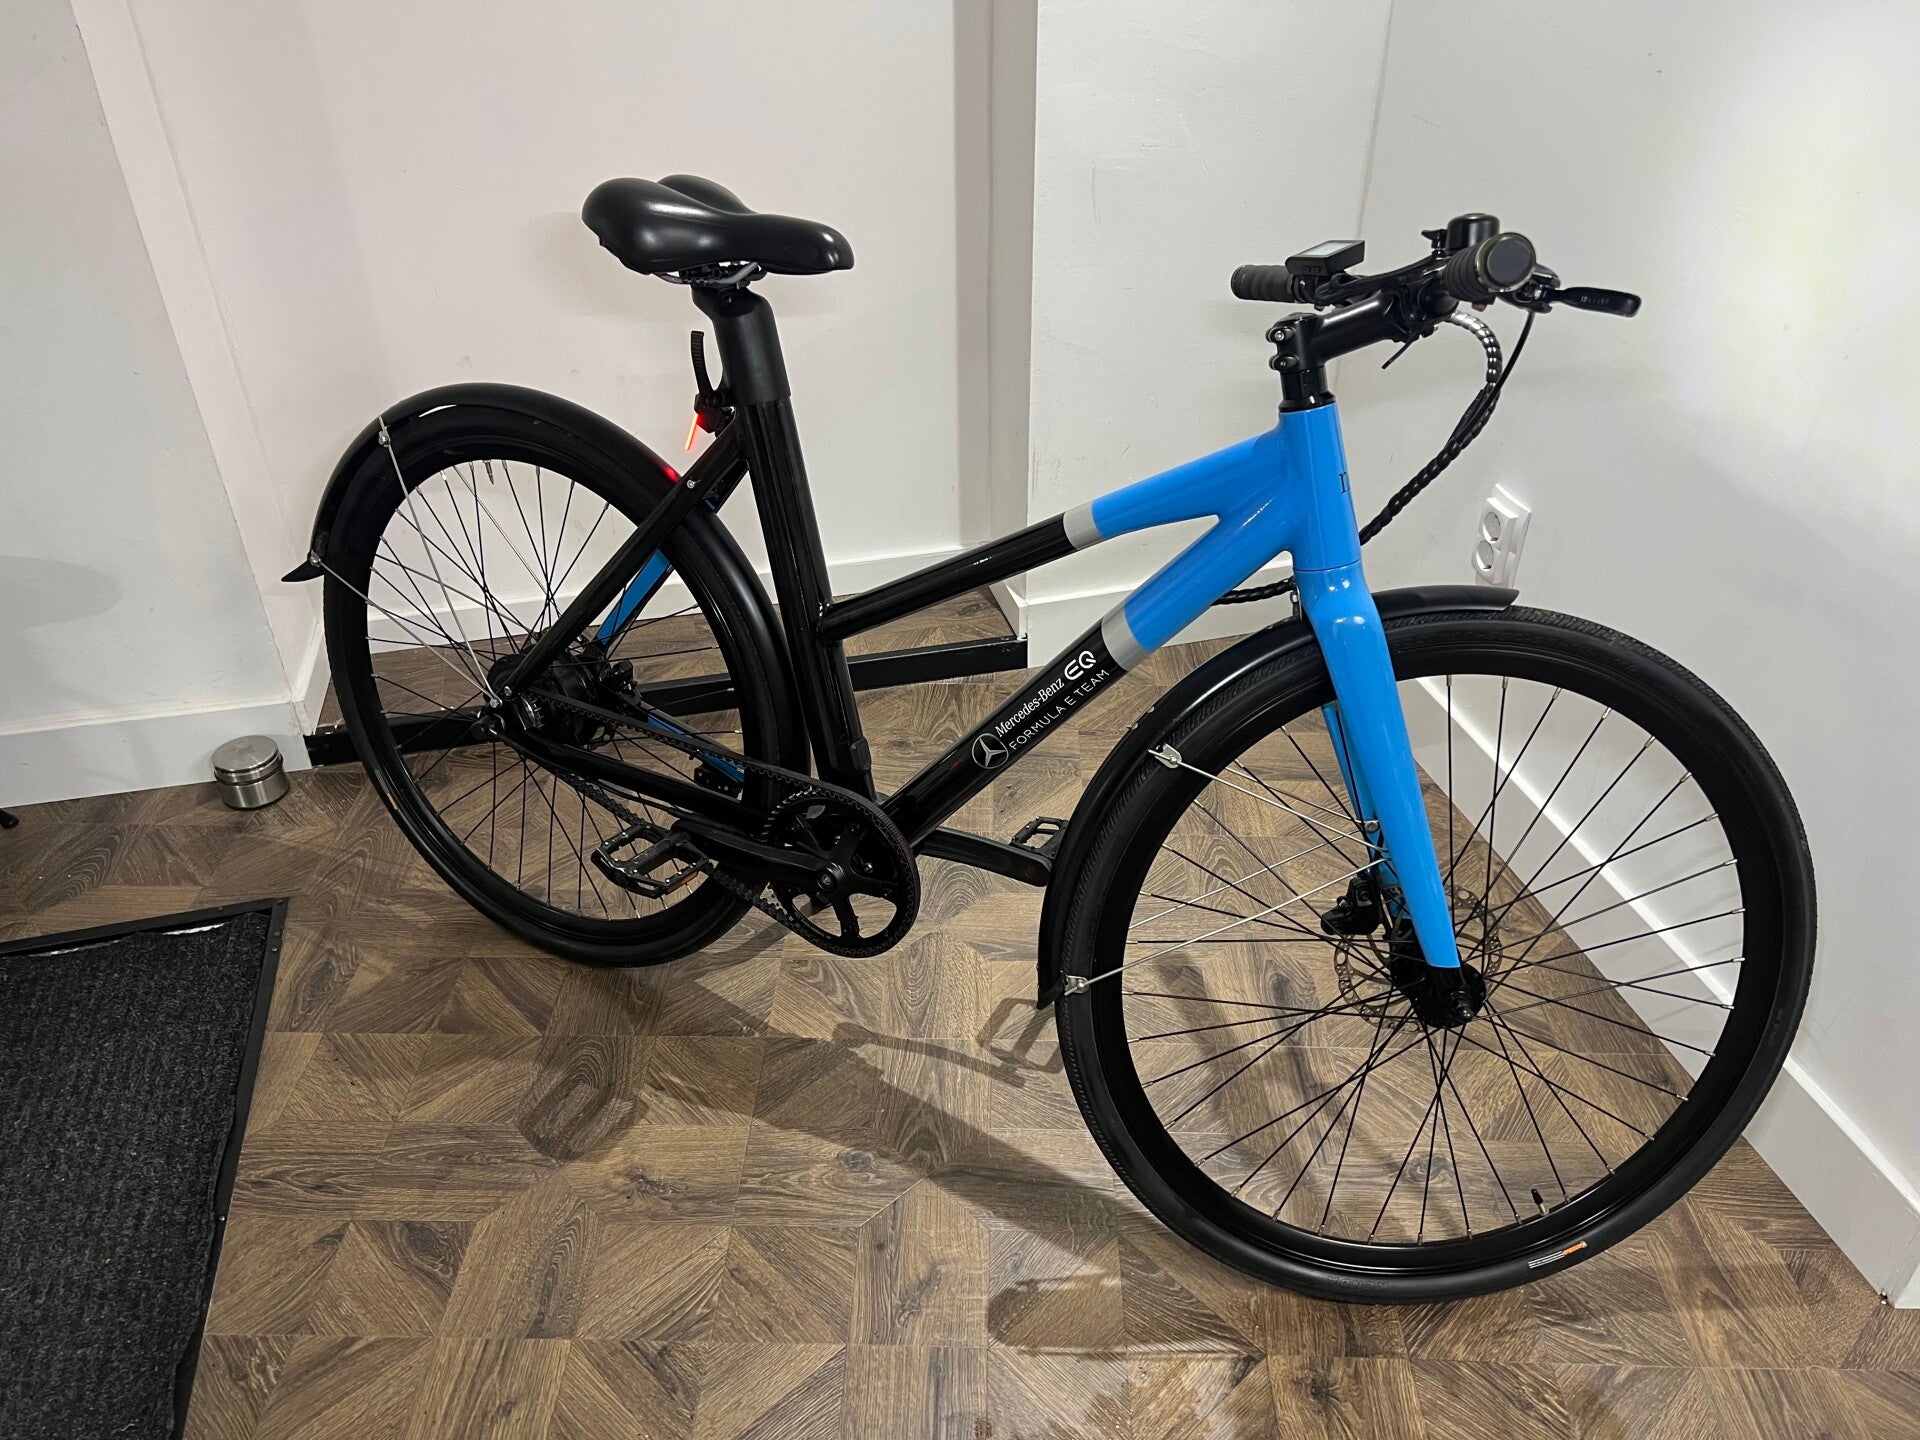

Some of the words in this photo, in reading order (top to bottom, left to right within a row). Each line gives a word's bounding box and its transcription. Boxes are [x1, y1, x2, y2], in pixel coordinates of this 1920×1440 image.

[995, 677, 1065, 738] Mercedes-Benz
[1064, 650, 1096, 681] EQ
[1008, 705, 1067, 750] FORMULA
[1064, 695, 1076, 706] E
[1073, 669, 1110, 697] TEAM
